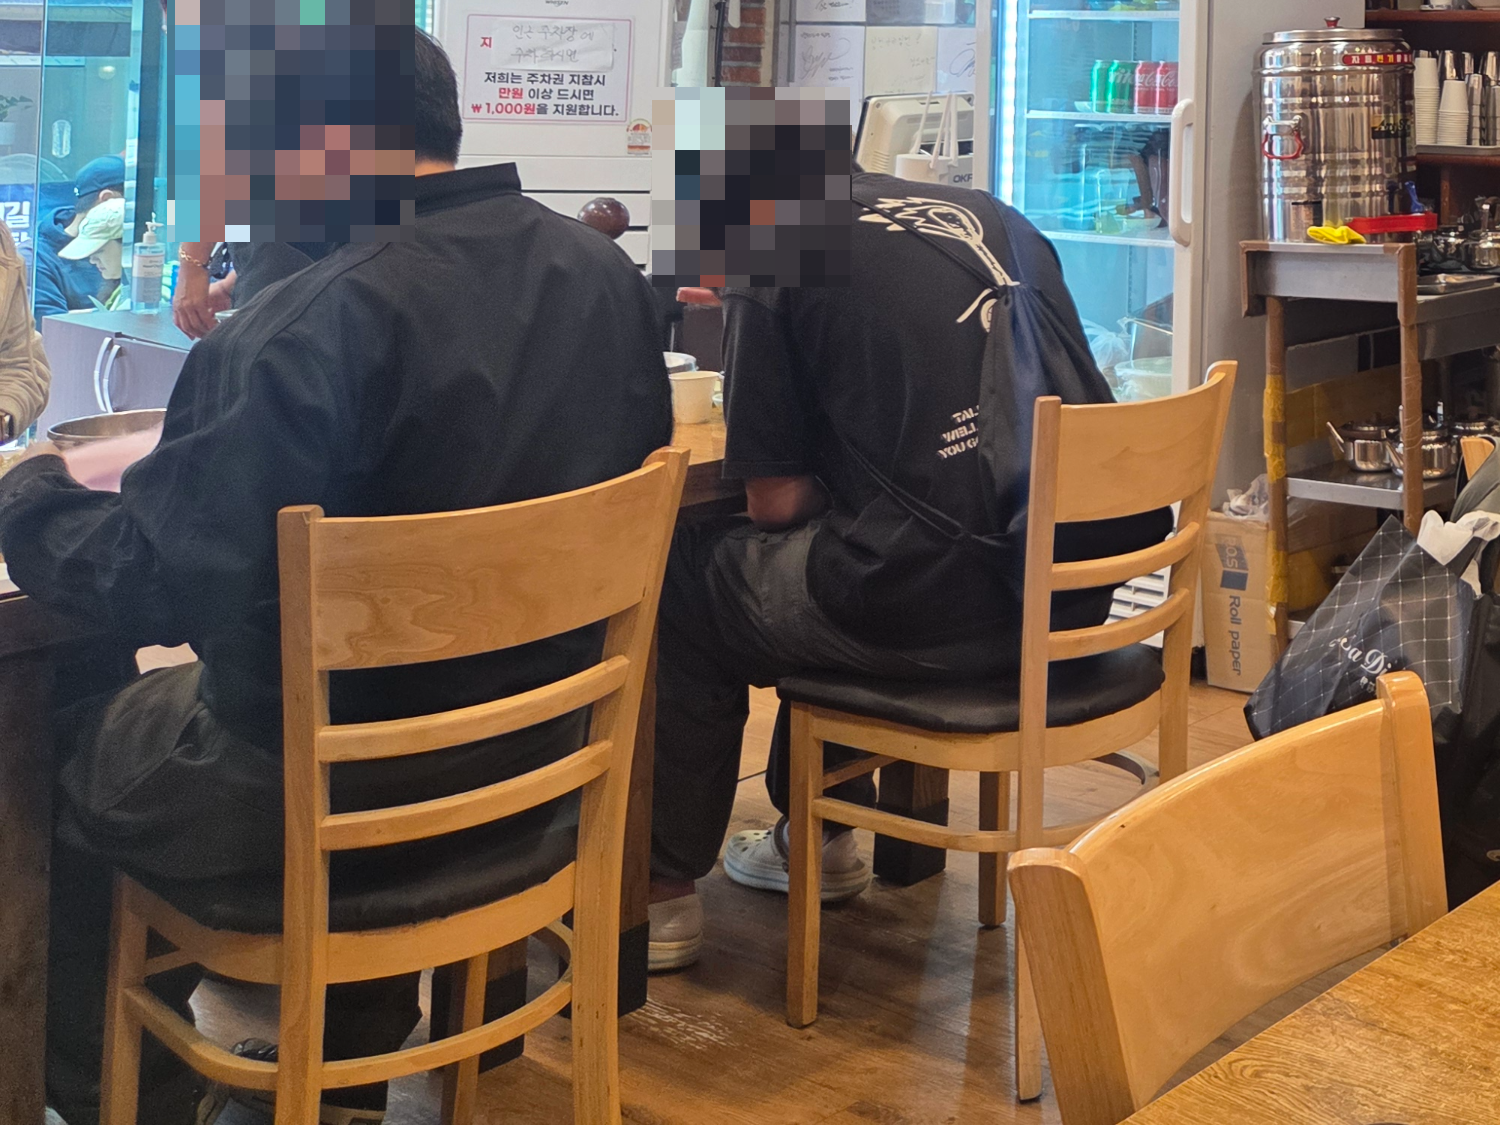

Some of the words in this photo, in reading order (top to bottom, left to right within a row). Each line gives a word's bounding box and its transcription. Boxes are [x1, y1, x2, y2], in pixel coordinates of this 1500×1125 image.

[484, 71, 522, 84] 저희는
[527, 73, 564, 85] 주차권
[568, 74, 606, 87] 지참시
[498, 87, 523, 99] 만원
[528, 88, 553, 100] 이상
[556, 89, 594, 101] 드시면
[552, 103, 619, 117] 지원합니다.
[1229, 595, 1242, 625] Roll
[1228, 630, 1242, 676] paper
